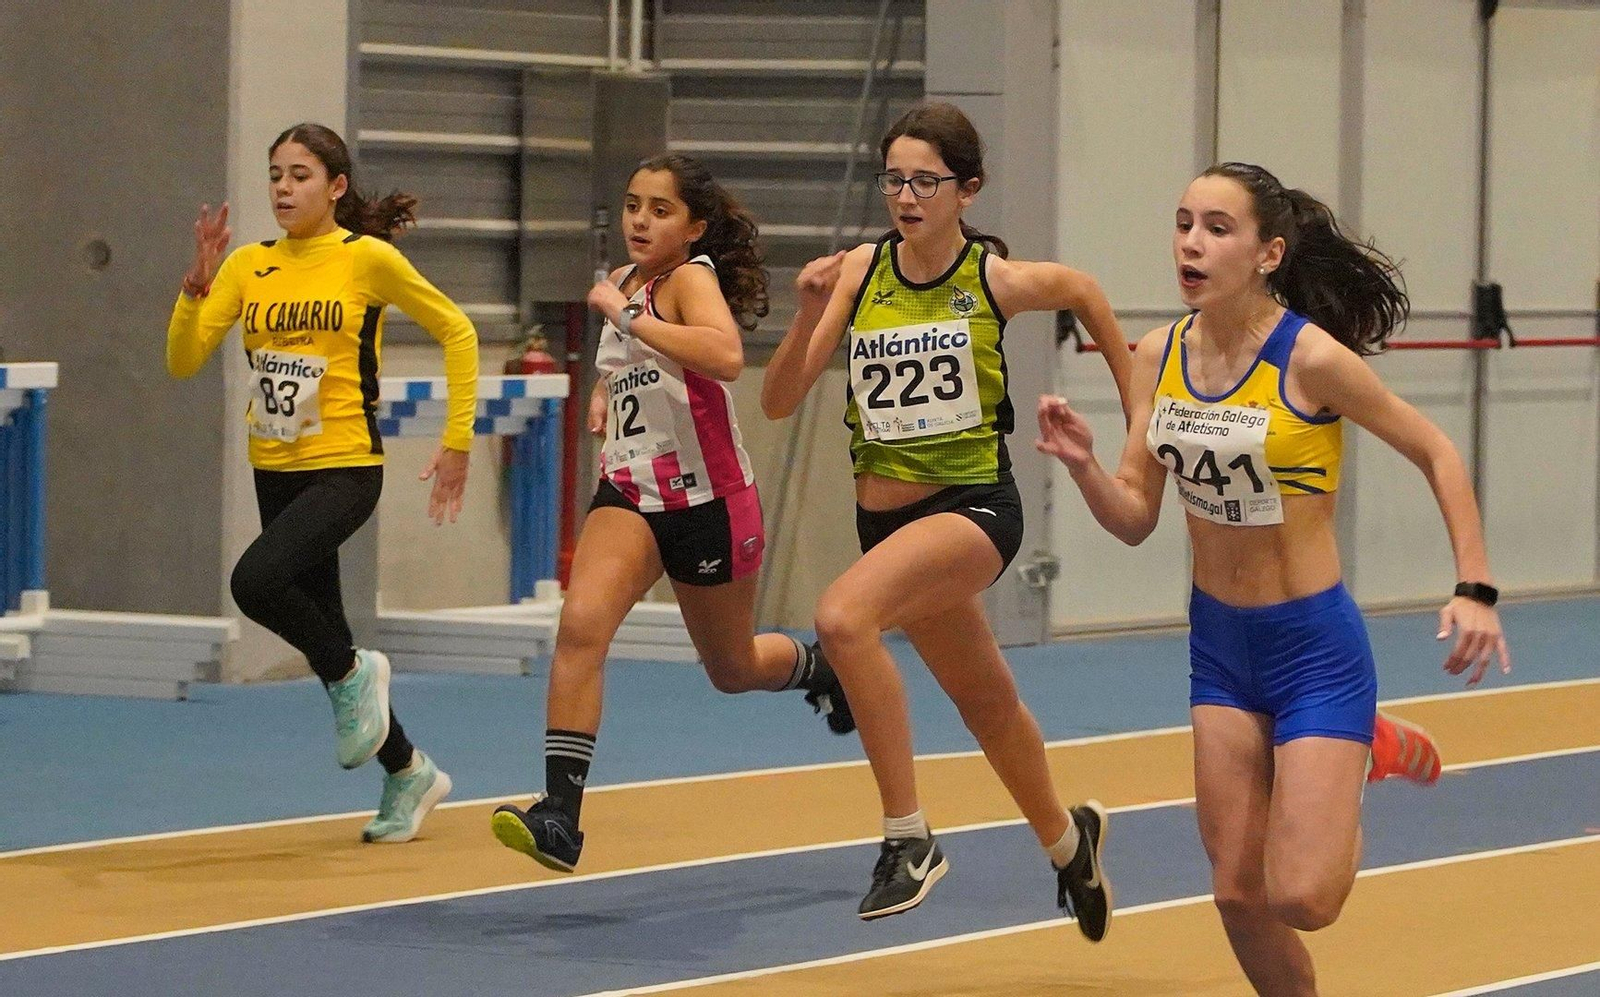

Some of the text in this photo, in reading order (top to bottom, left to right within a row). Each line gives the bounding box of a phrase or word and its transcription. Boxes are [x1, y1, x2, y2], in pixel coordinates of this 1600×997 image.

[245, 300, 343, 334] EL CANARIO
[853, 327, 968, 360] Atlántico
[252, 353, 324, 378] lántico
[862, 354, 963, 409] 223
[260, 376, 300, 417] 83
[1167, 402, 1220, 421] Federación
[1165, 420, 1230, 437] de Atletismo
[1157, 443, 1265, 497] 241
